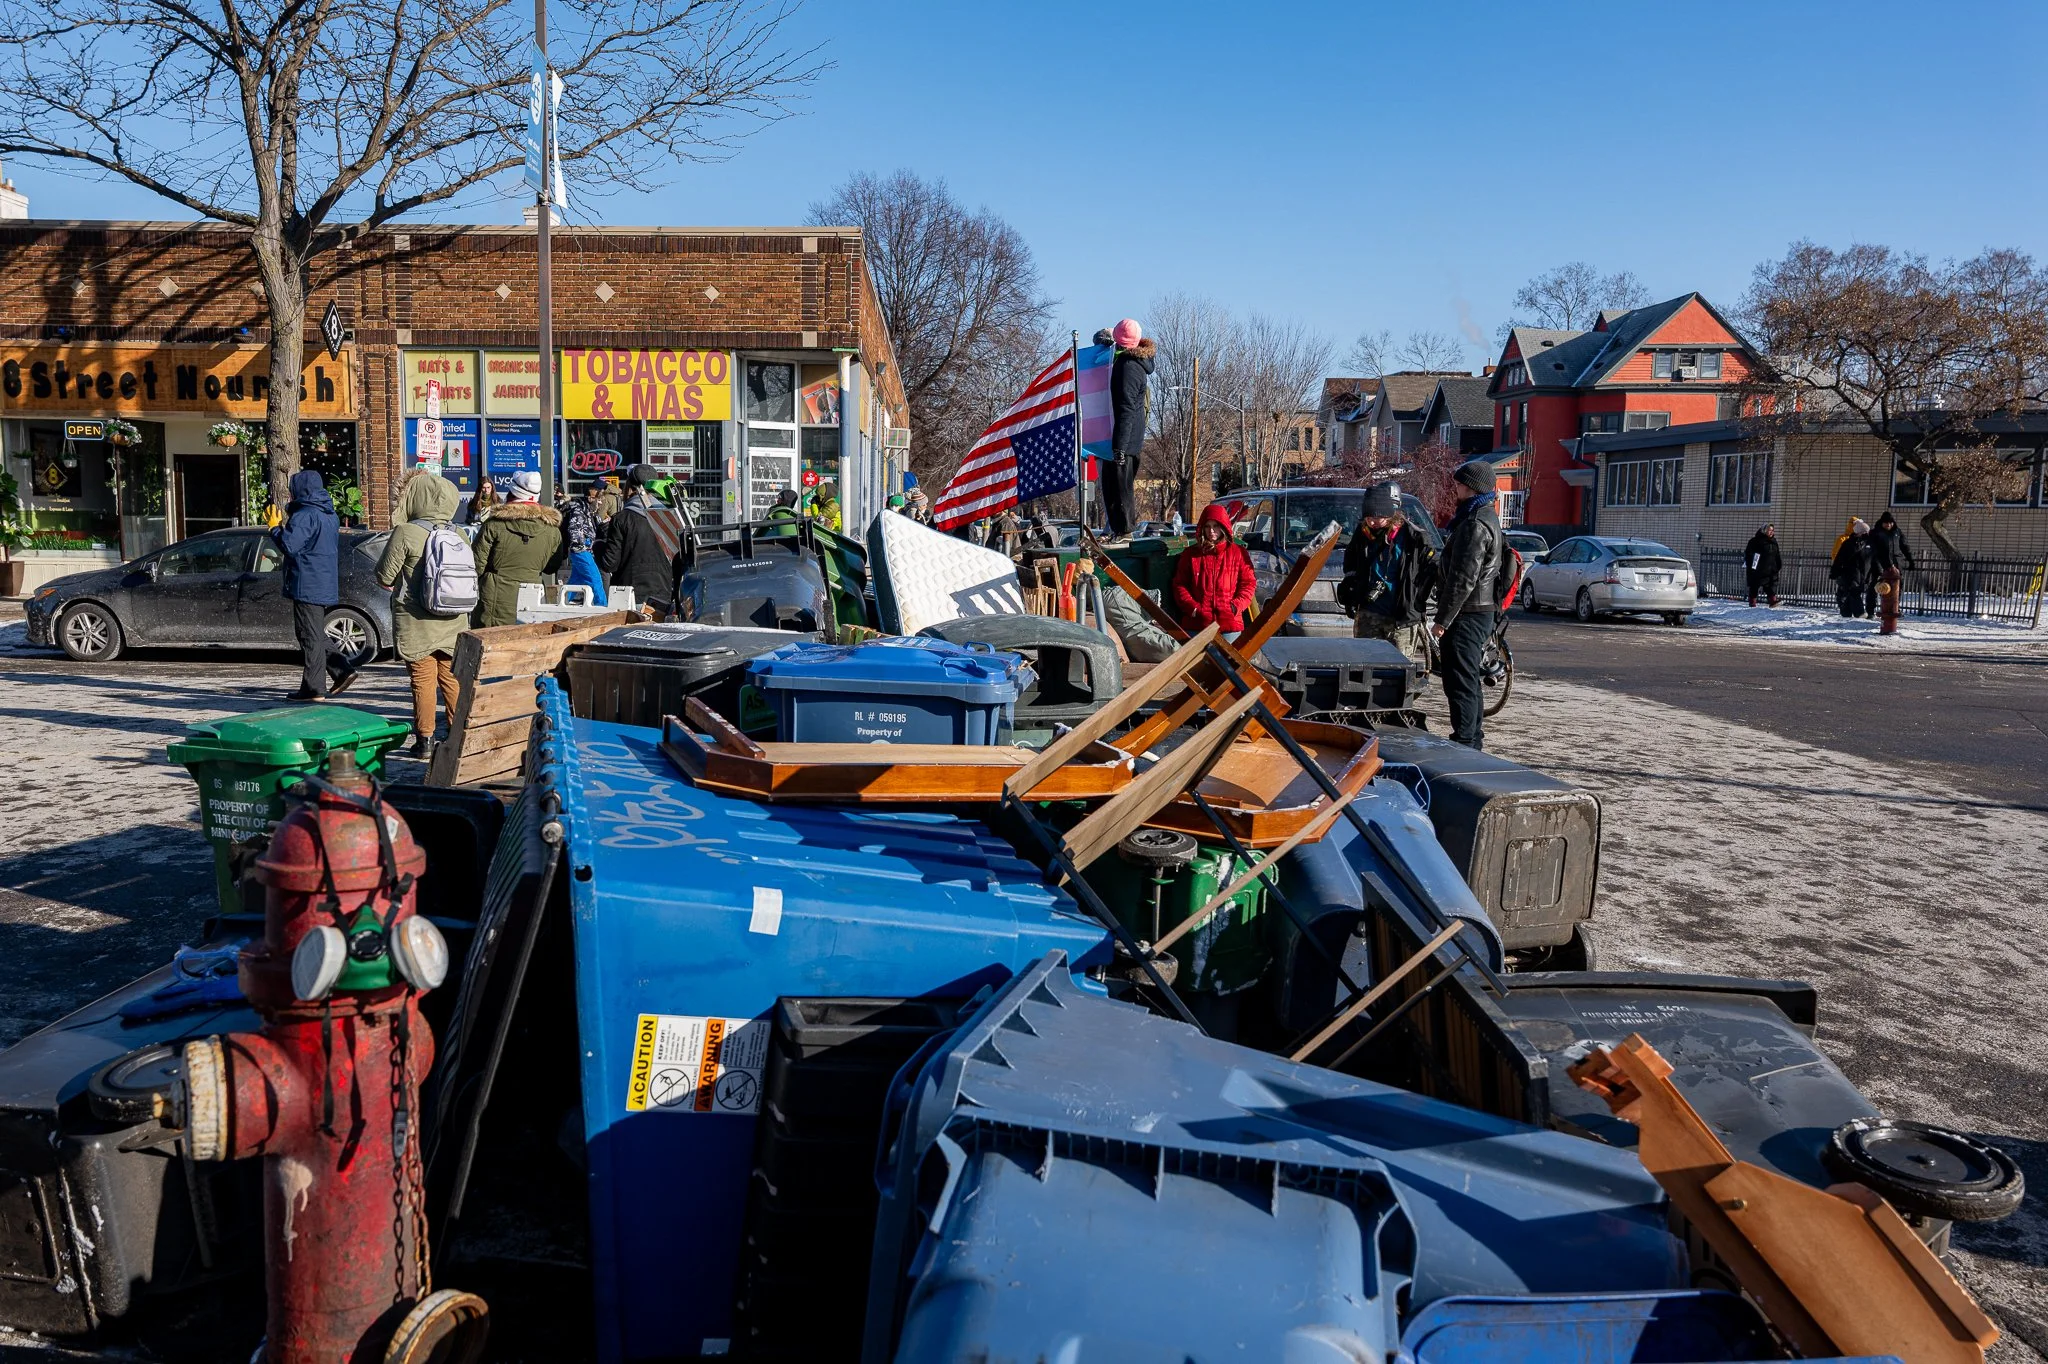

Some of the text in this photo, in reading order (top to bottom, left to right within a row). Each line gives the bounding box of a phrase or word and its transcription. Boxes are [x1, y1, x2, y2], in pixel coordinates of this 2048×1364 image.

[332, 314, 338, 340] 8
[418, 360, 464, 374] HATS &
[488, 360, 524, 374] ORGANIC
[564, 348, 727, 384] TOBACCO
[31, 360, 158, 401] Street
[177, 364, 335, 403] Noursh
[414, 386, 472, 400] T-IRTS
[591, 384, 704, 420] & MAS
[68, 426, 102, 436] OPEN
[572, 452, 618, 472] OPEN
[48, 468, 58, 484] 8
[868, 712, 875, 720] #
[879, 712, 906, 723] 059195
[857, 728, 902, 738] Property of
[234, 781, 260, 792] 037176
[209, 799, 269, 814] PROPERTY OF
[212, 814, 267, 828] THE CITY OF
[210, 827, 258, 840] MINNEAP
[634, 1020, 654, 1092] CAUTION
[700, 1024, 722, 1097] WARNING
